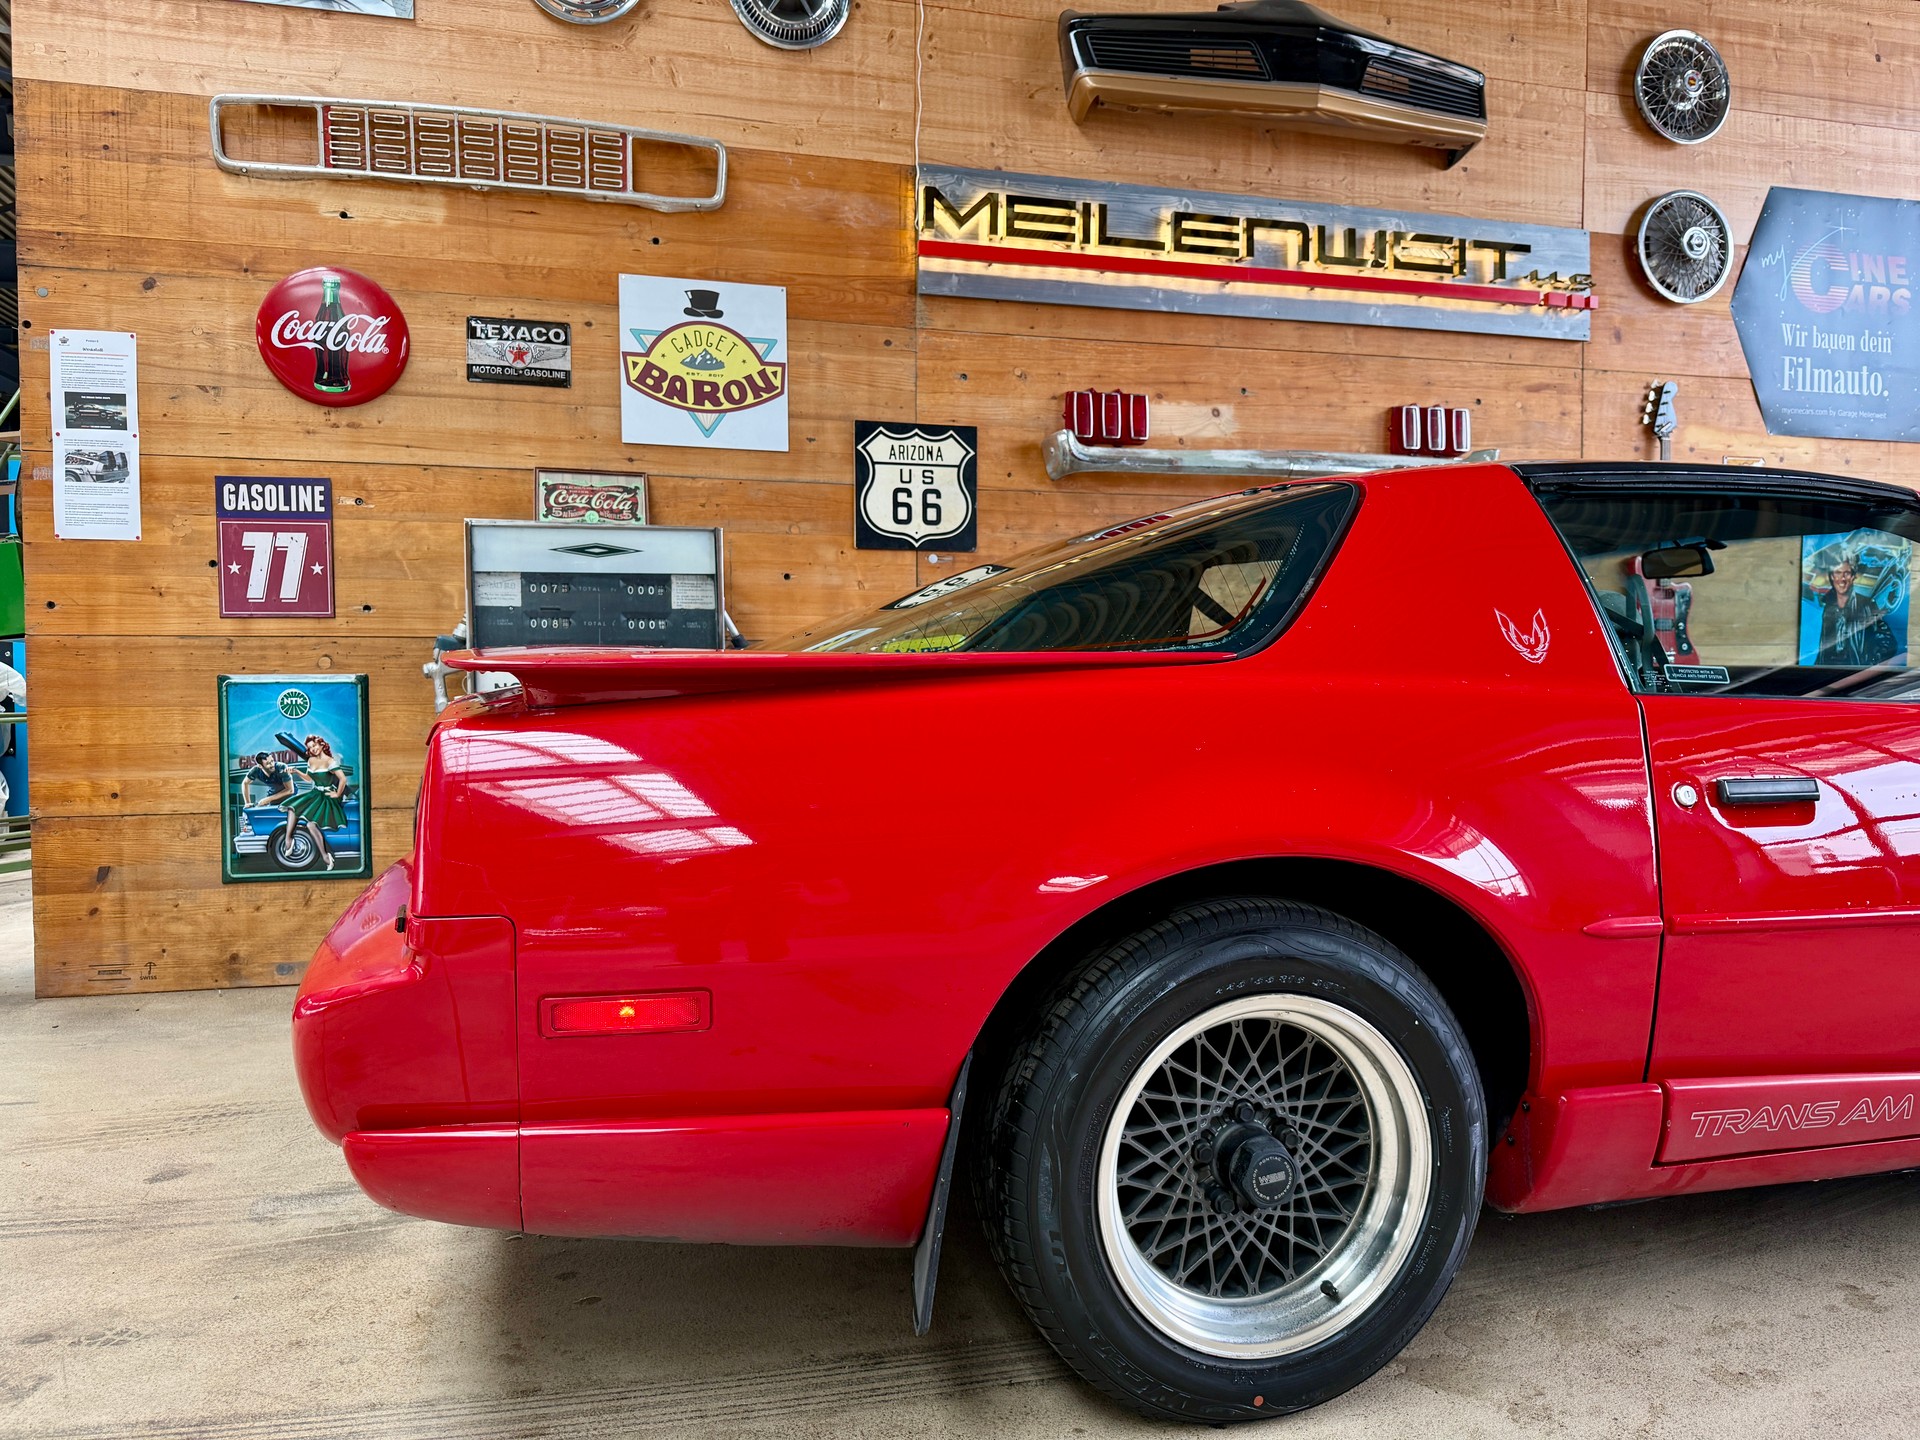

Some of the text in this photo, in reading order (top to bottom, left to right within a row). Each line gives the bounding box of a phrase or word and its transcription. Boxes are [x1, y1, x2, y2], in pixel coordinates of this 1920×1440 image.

[270, 310, 391, 354] Coca-Cola
[472, 322, 566, 343] TEXACO
[671, 330, 738, 357] GADGET
[1781, 322, 1892, 353] Wir bauen dein
[472, 365, 566, 379] MOTOR OIL GASOLINE
[633, 359, 780, 408] BARON
[1781, 356, 1889, 397] Filmauto.
[889, 444, 944, 461] ARIZONA
[223, 483, 325, 512] GASOLINE
[892, 487, 942, 526] 66
[241, 531, 308, 603] 77
[1690, 1093, 1915, 1138] TRANS AM
